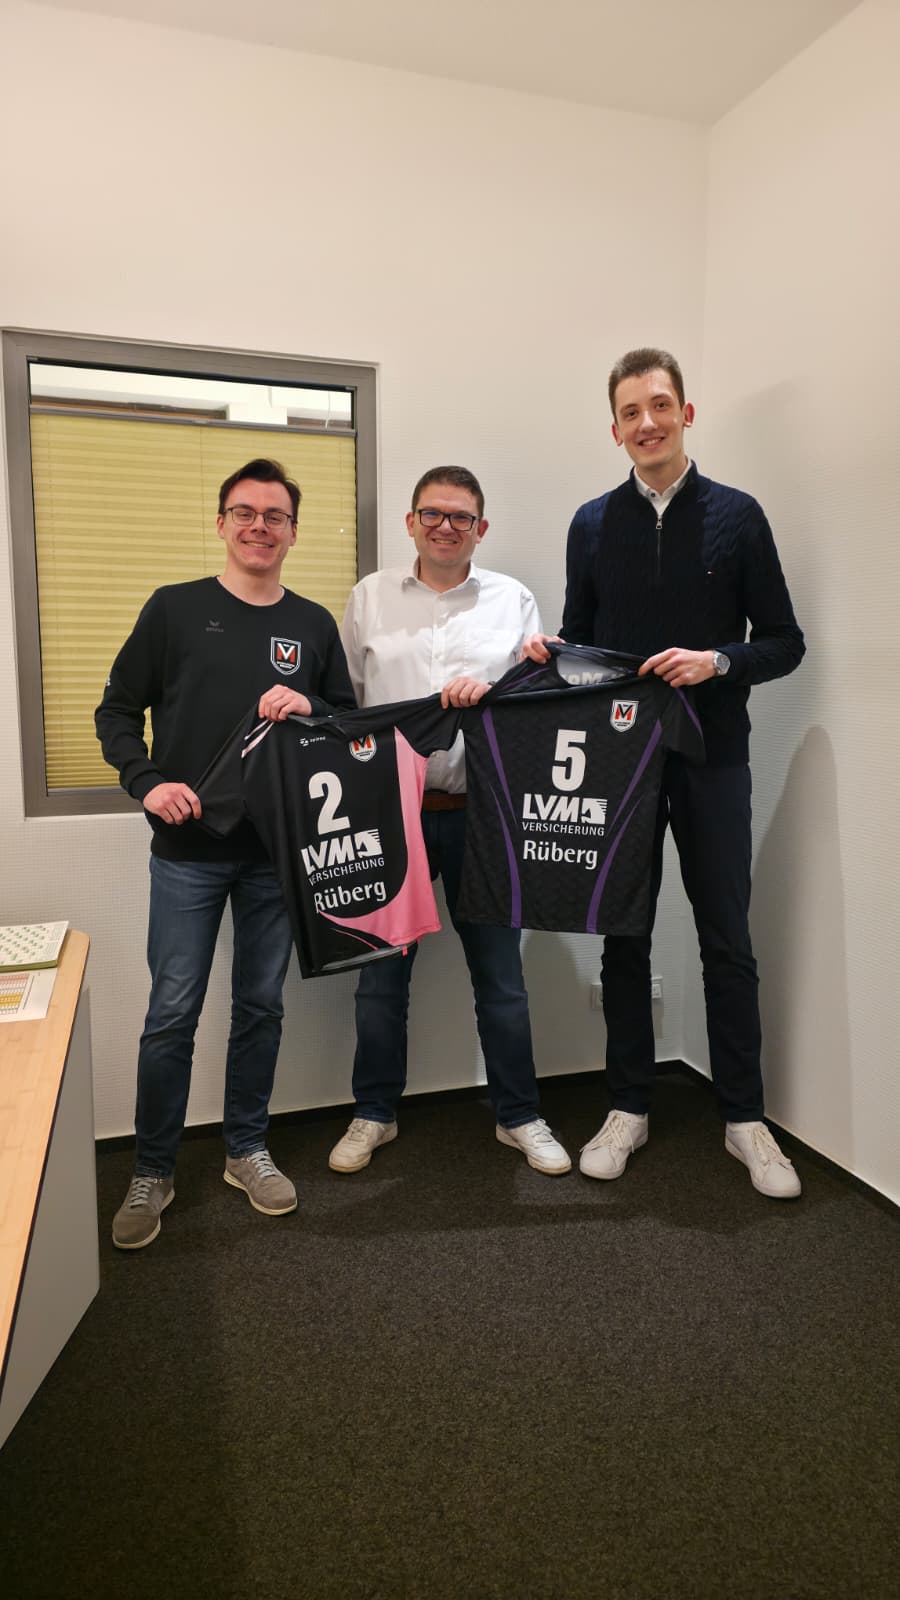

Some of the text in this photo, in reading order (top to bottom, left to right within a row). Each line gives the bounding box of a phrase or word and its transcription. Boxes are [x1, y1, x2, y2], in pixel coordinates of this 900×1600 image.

[551, 730, 587, 791] 5
[308, 771, 350, 835] 2
[522, 793, 579, 823] LVM
[522, 823, 605, 837] VERSICHERUNG
[301, 836, 355, 876] LVM
[523, 839, 598, 870] Rüberg
[314, 881, 386, 914] Rüberg
